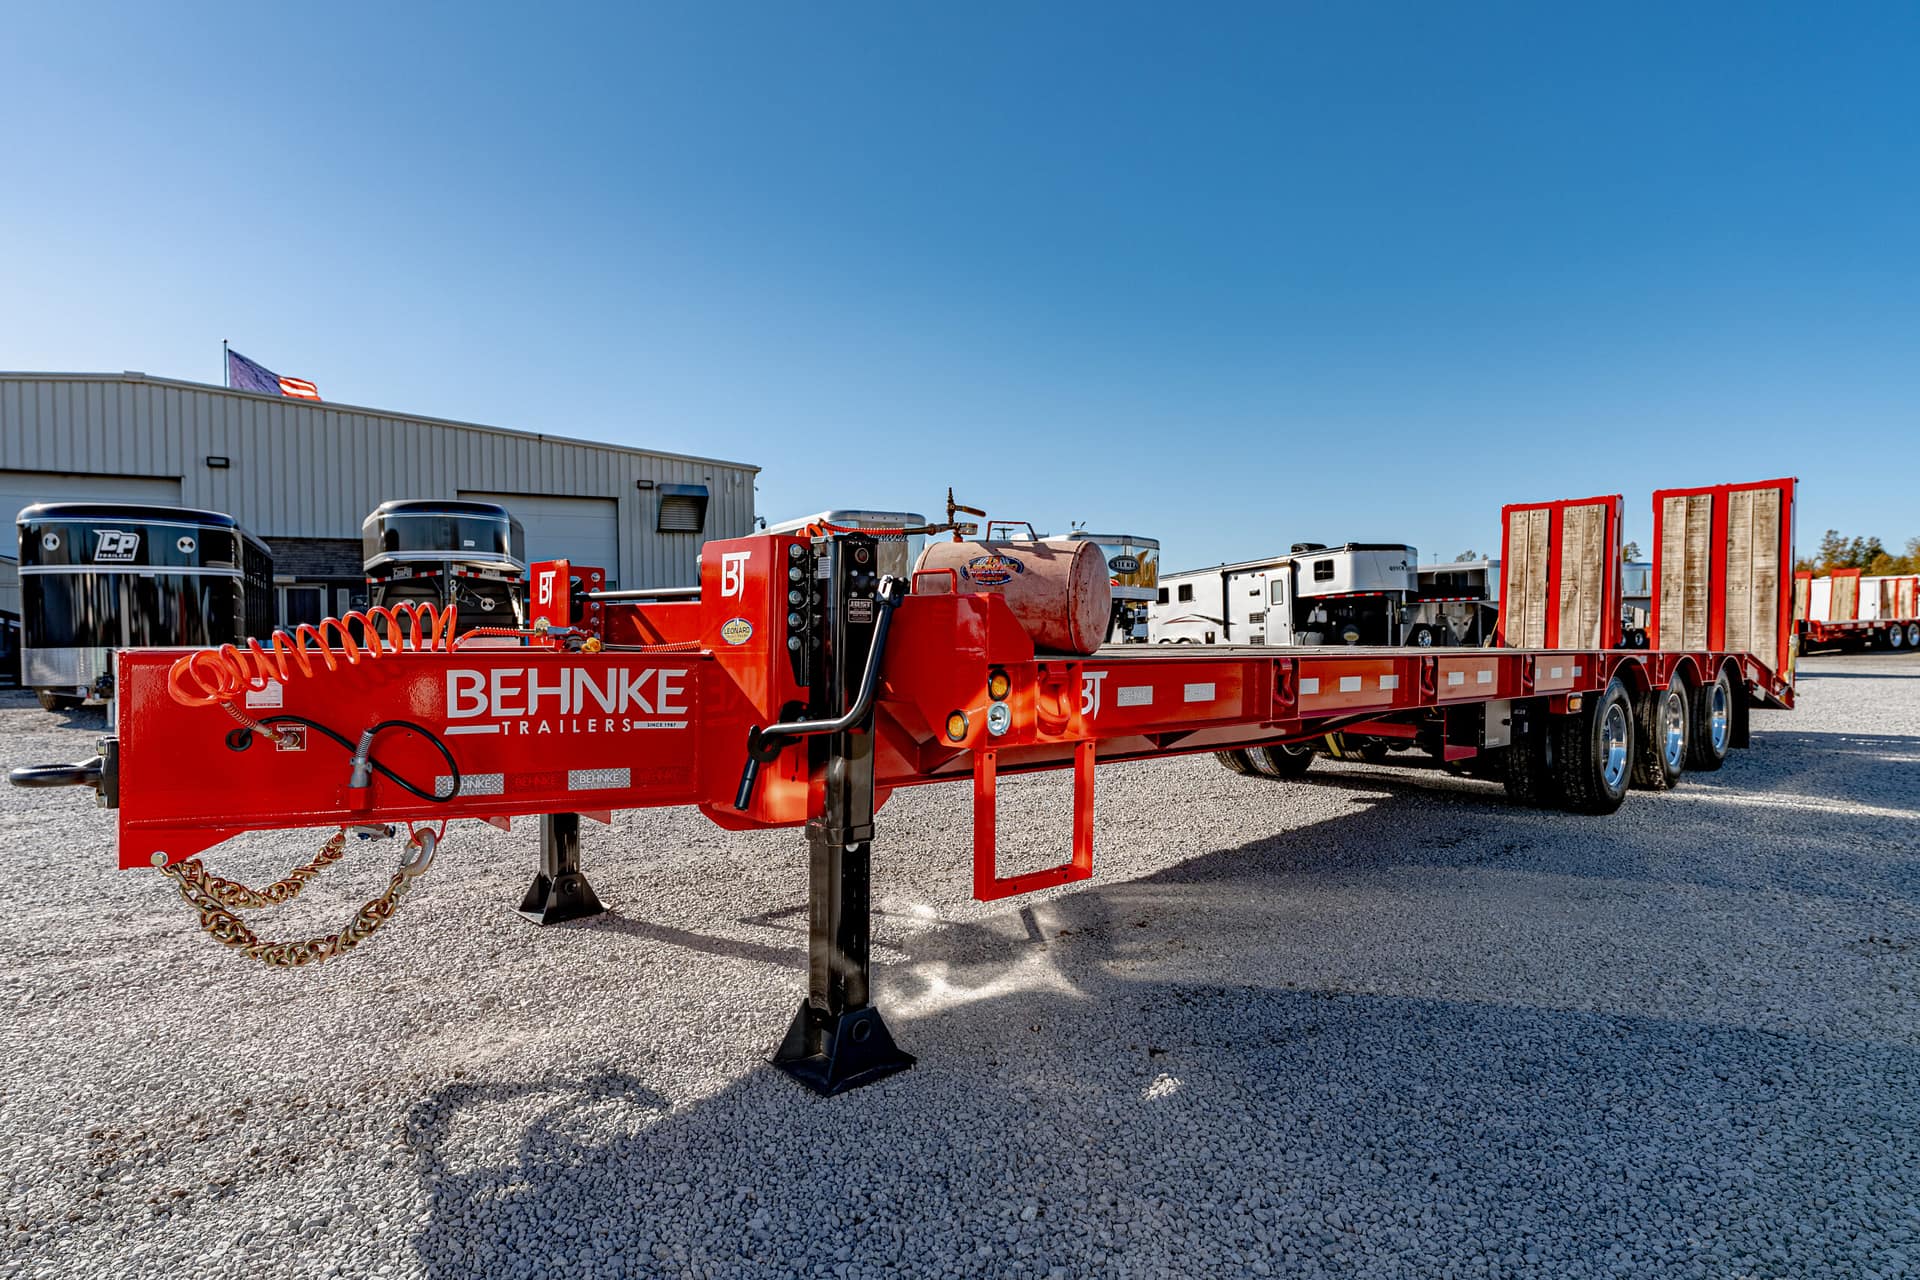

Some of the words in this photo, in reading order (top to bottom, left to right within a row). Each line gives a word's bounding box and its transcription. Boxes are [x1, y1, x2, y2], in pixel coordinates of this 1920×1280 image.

[100, 532, 136, 554] CP
[446, 667, 688, 719] BEHNKE
[502, 718, 632, 736] TRAILERS
[447, 779, 492, 790] BHNKE
[579, 774, 619, 784] BEHNKE
